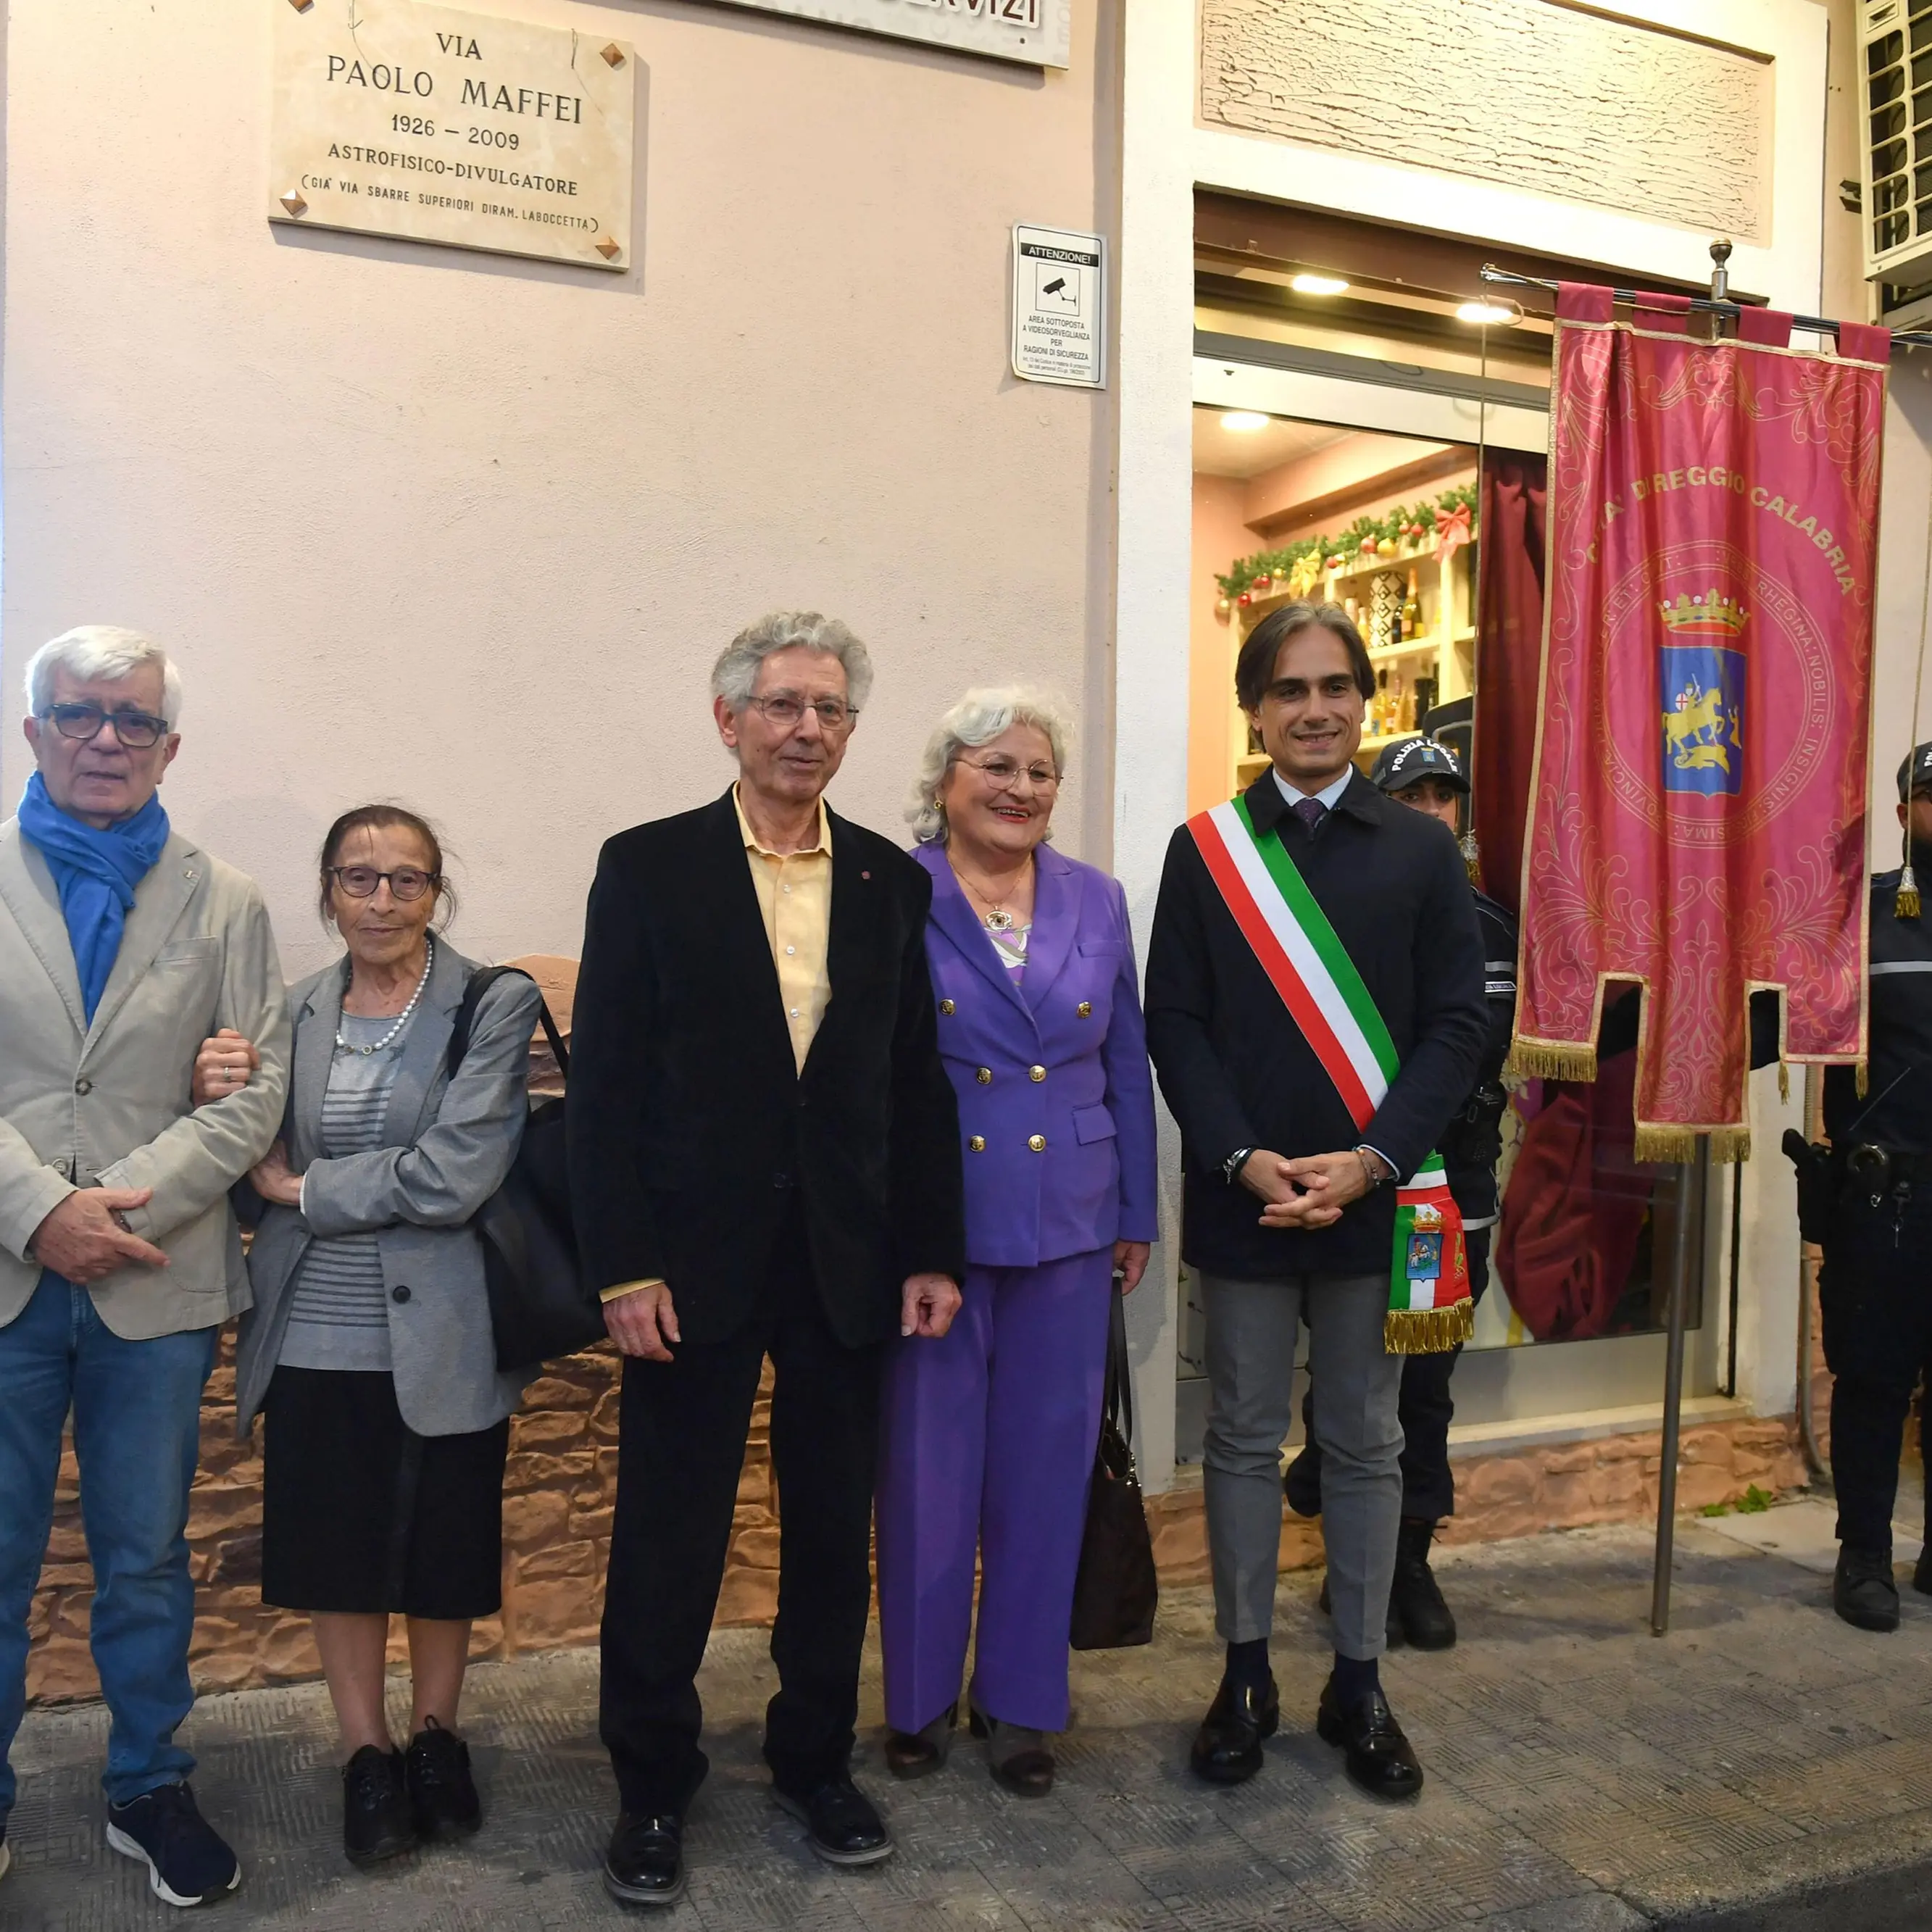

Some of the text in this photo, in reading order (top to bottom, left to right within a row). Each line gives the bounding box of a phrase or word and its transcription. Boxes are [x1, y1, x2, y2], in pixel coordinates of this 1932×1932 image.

[436, 33, 483, 60] VIA
[327, 55, 582, 125] PAOLO MAFFEI
[391, 114, 435, 136] 1926
[468, 127, 520, 151] 2009
[328, 143, 578, 196] ASTROFISICO-DIVULGATORE
[340, 180, 359, 194] VIA
[367, 186, 410, 202] SBARRE
[418, 193, 474, 212] SUPERIORI
[482, 203, 518, 219] DIRAM.
[1028, 246, 1091, 265] ATTENZIONE!
[1028, 315, 1085, 330] AREA SOTTOPOSTA
[1028, 325, 1091, 341] VIDEOSORVEGLIANZA
[1023, 345, 1048, 355] RAGIONI
[1057, 349, 1089, 360] SICUREZZA
[1652, 466, 1745, 494] REGGIO
[1750, 486, 1855, 596] CALABRIA
[1391, 739, 1459, 773] POLIZIA LOCALE
